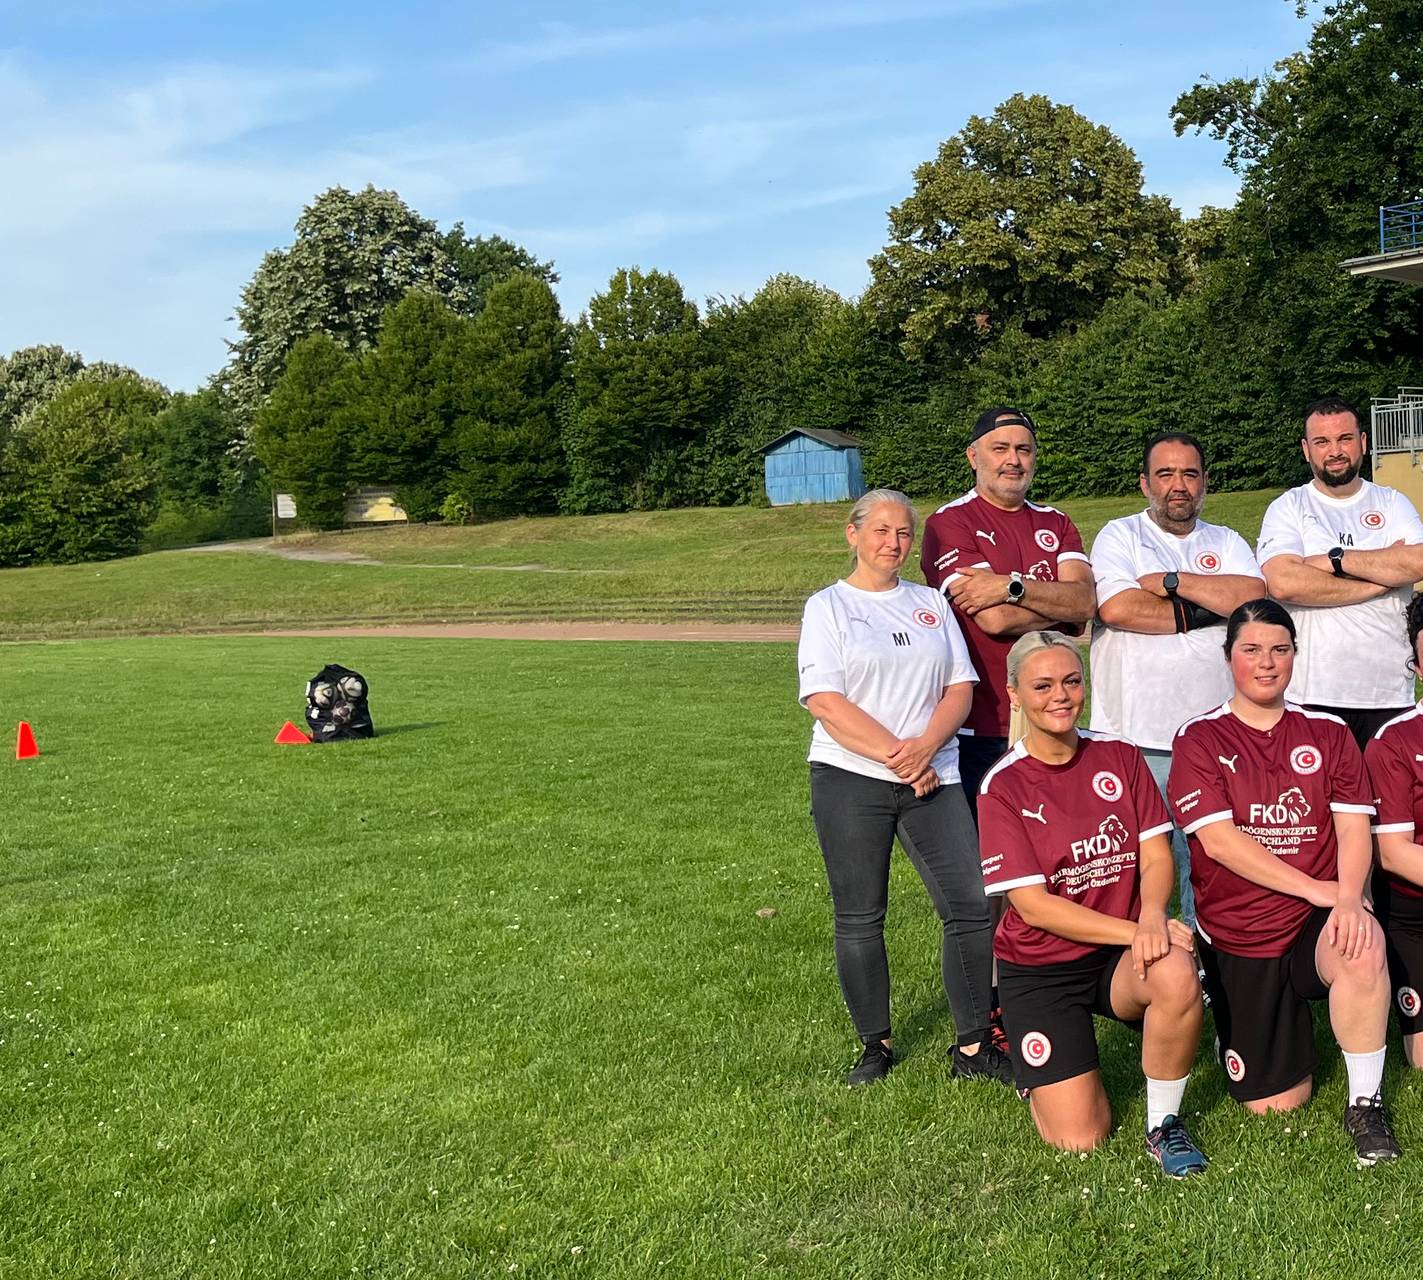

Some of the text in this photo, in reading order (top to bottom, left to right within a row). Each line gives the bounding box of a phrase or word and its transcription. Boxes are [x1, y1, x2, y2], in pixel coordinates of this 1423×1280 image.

[1339, 532, 1354, 546] KA
[892, 632, 911, 646] MI
[1249, 804, 1288, 824] FKD
[1071, 834, 1112, 863] FKD
[1065, 864, 1122, 886] DEUTSCHLAND
